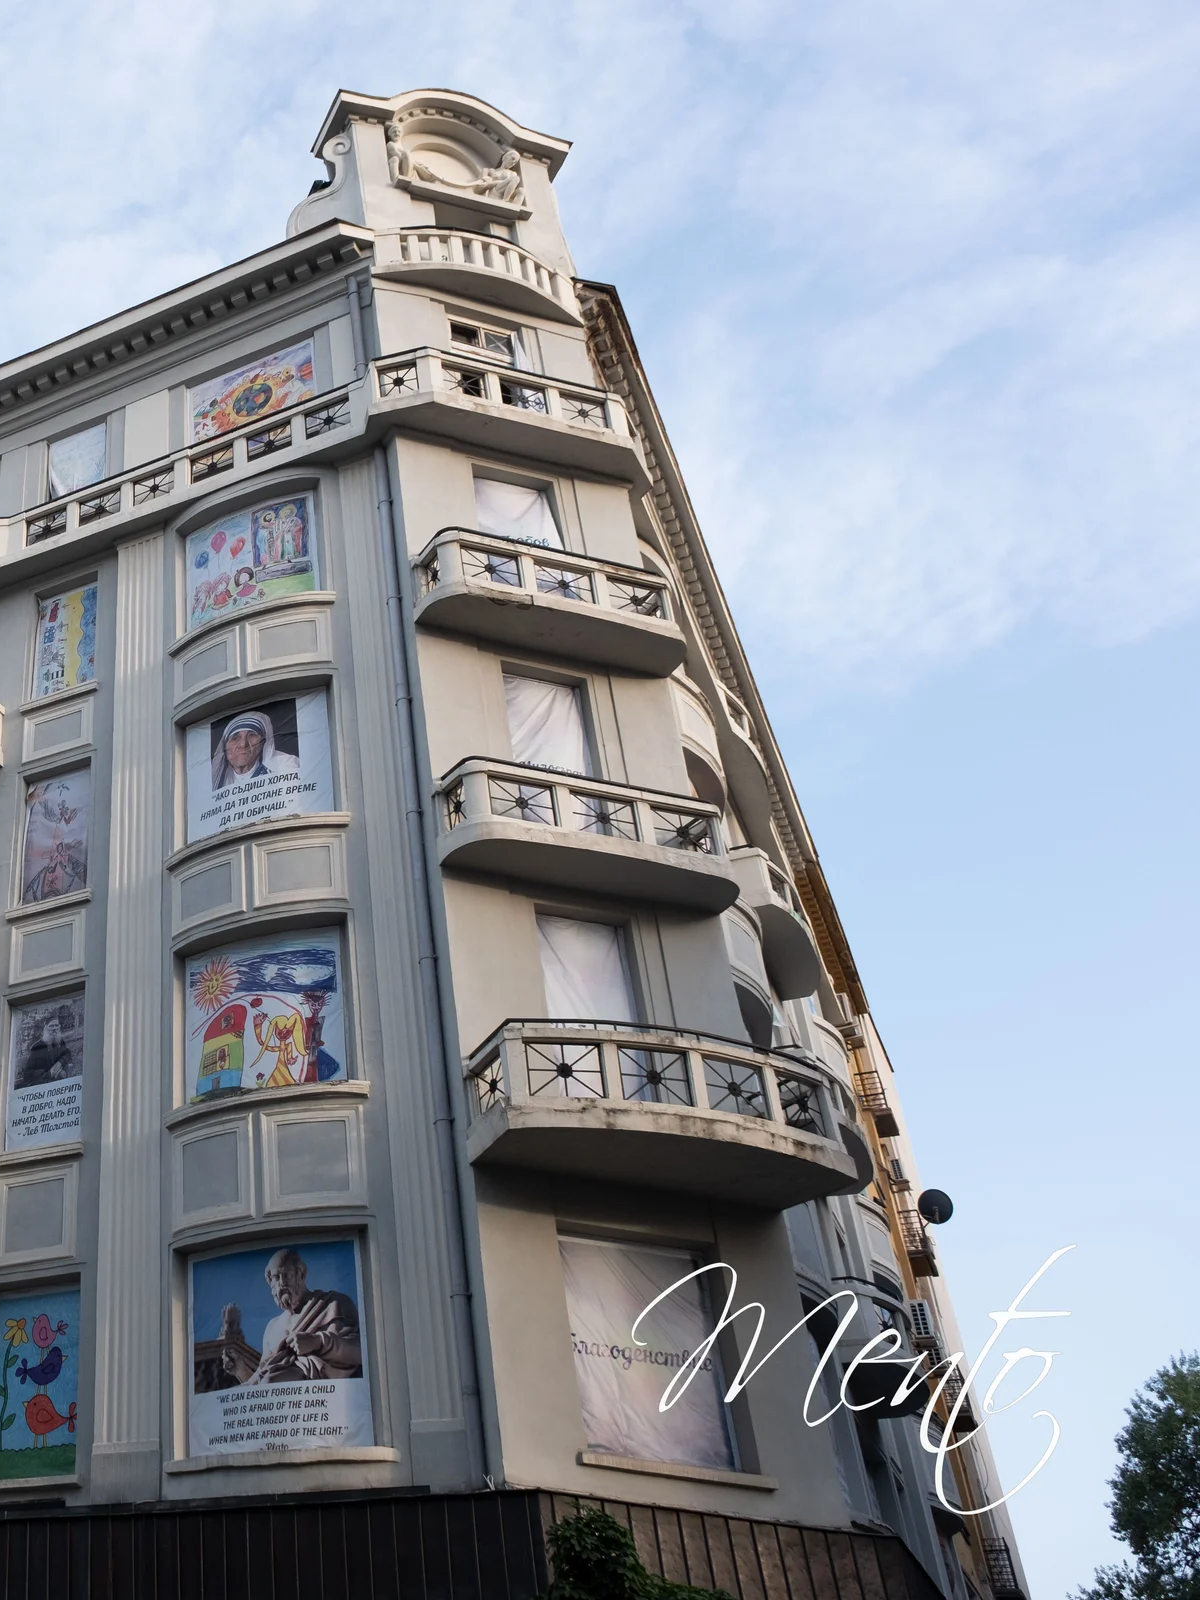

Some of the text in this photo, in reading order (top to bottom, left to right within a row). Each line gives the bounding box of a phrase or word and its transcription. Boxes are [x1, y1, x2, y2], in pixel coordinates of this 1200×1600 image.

[232, 779, 265, 795] СЪДИШ
[267, 772, 301, 785] ХОРАТА,
[200, 782, 317, 822] НЯМА ДА ТИ ОСТАНЕ ВРЕМЕ
[219, 816, 231, 828] ДА
[233, 812, 244, 822] ГИ
[47, 1083, 82, 1097] ПОВЕРИТЬ
[22, 1095, 76, 1114] В ДОБРО, НАДО
[12, 1116, 37, 1128] НАЧАТЬ
[38, 1110, 65, 1122] ДЕЛАТЬ
[231, 1392, 244, 1403] CAN
[246, 1389, 269, 1400] EASILY
[271, 1386, 302, 1397] FORGIVE
[304, 1386, 310, 1394] A
[312, 1384, 335, 1394] CHILD
[223, 1406, 238, 1416] WHO
[240, 1405, 247, 1414] IS
[249, 1402, 274, 1413] AFRAID
[276, 1401, 286, 1410] OF
[289, 1400, 302, 1409] THE
[224, 1412, 328, 1430] THE REAL TRAGEDY OF LIFE IS
[209, 1434, 228, 1446] WHEN
[230, 1433, 244, 1443] MEN
[246, 1431, 260, 1441] ARE
[261, 1429, 288, 1440] AFRAID
[290, 1428, 300, 1437] OF
[302, 1427, 317, 1436] THE
